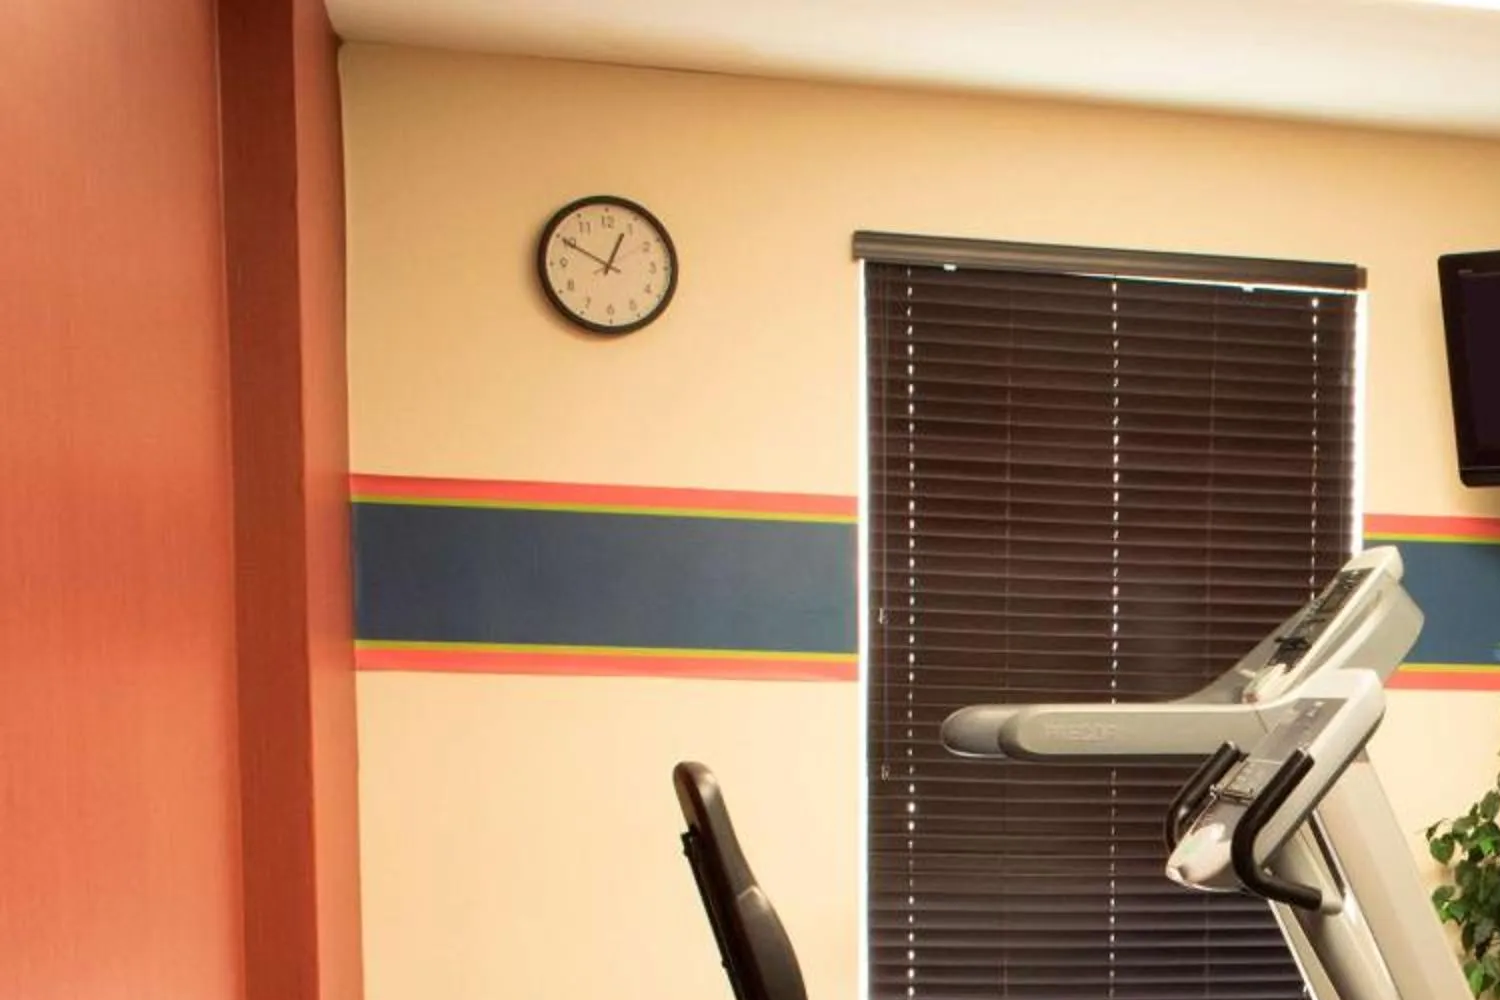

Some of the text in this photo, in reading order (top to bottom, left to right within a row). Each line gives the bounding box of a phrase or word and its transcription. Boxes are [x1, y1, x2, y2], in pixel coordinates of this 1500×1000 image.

[601, 214, 615, 229] 12
[579, 222, 592, 235] 11
[606, 304, 615, 316] 6
